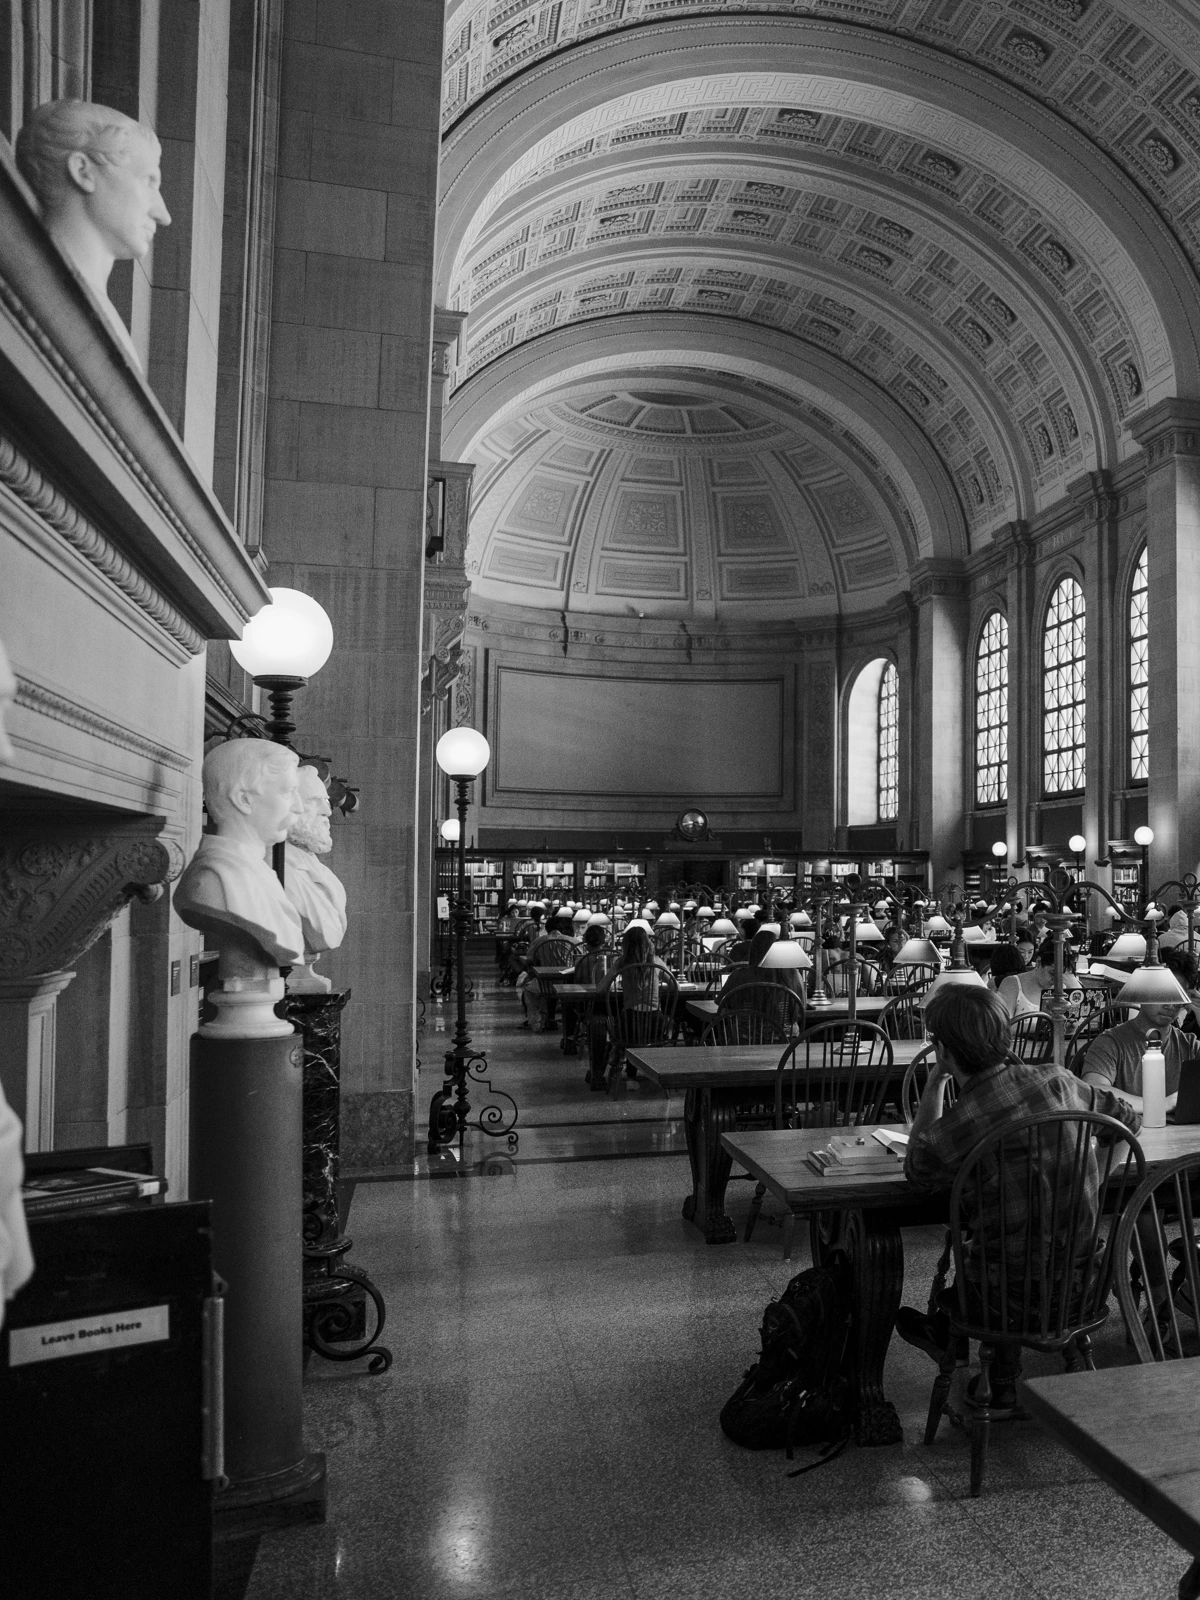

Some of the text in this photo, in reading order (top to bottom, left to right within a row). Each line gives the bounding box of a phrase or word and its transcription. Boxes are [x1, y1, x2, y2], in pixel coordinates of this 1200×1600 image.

[41, 1321, 142, 1346] Leave Books Here
